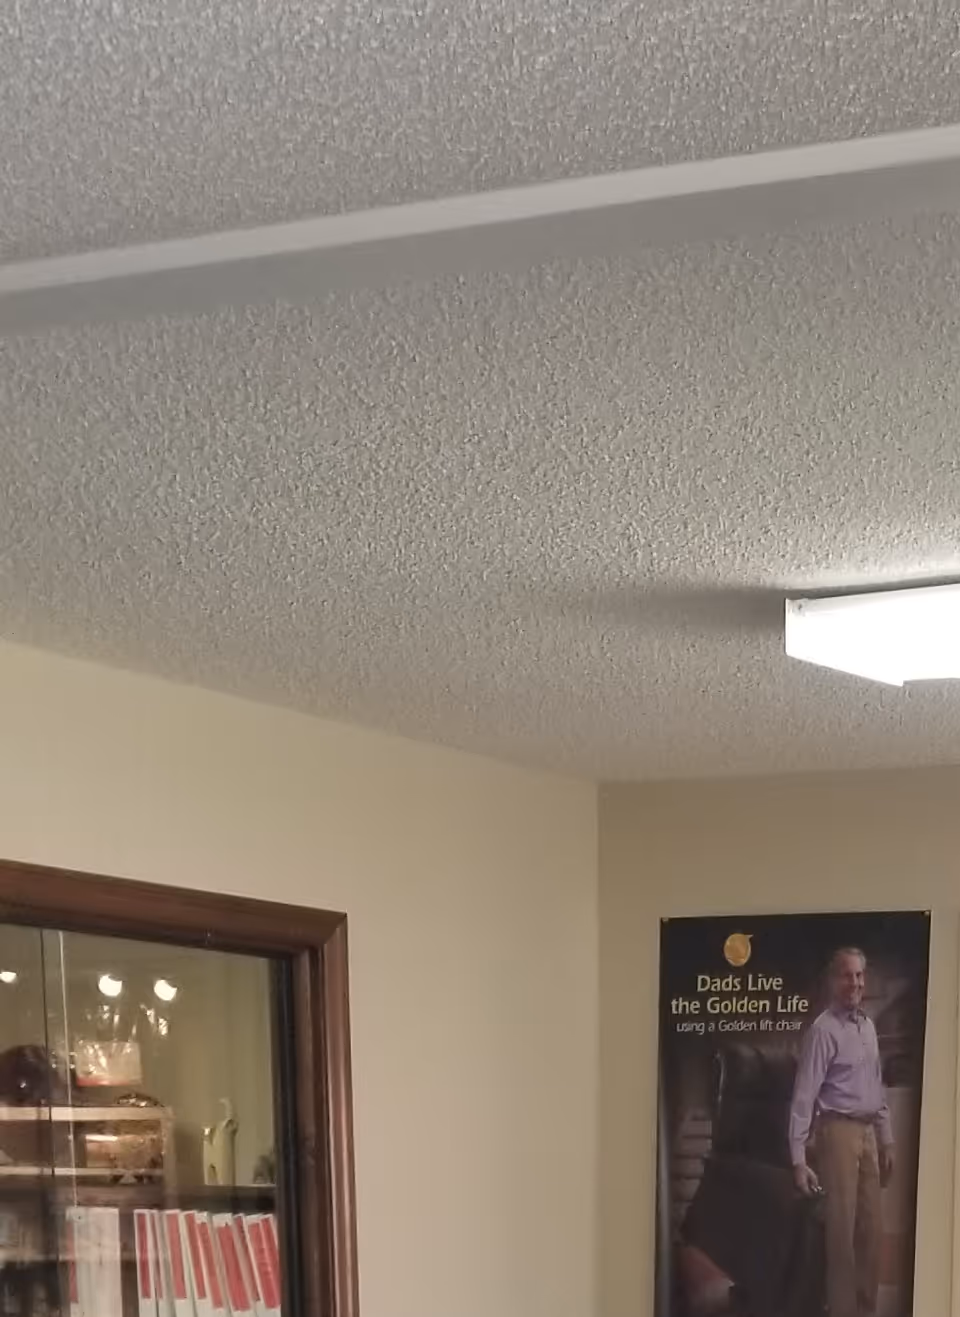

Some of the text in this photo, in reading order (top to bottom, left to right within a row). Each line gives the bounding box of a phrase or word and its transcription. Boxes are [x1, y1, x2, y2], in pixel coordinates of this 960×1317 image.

[697, 973, 783, 992] Dads Live
[671, 995, 809, 1014] the Golden Life
[677, 1019, 802, 1036] using a Golden lift chair
